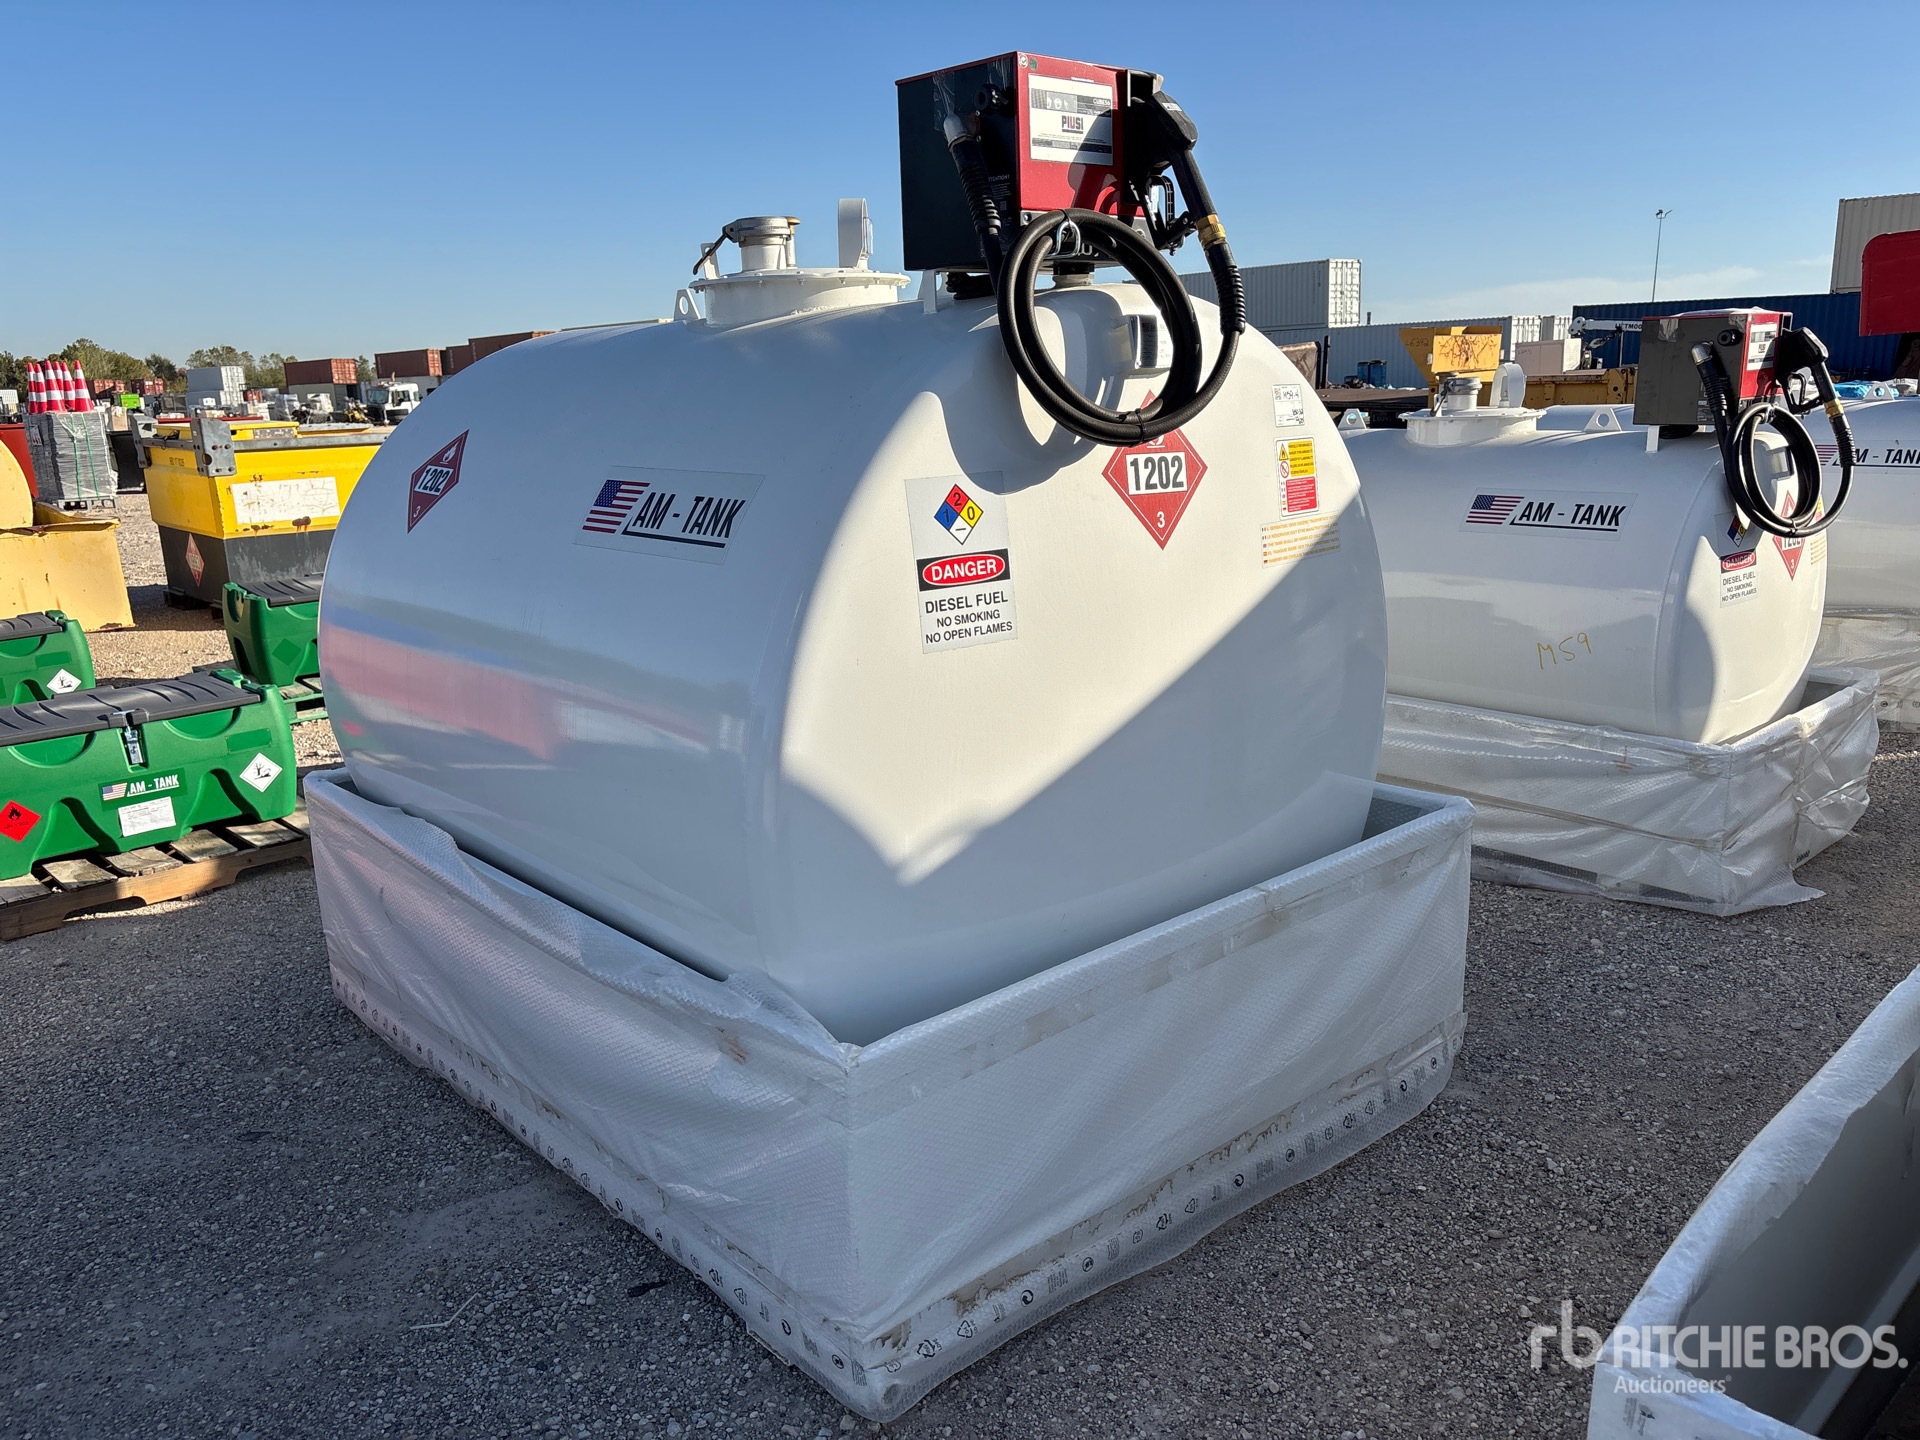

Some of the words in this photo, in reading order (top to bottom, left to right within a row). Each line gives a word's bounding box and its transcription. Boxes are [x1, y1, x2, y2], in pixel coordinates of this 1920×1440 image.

[1061, 115, 1084, 130] PIUSI
[417, 467, 451, 493] 1202
[1129, 455, 1185, 491] 1202
[953, 492, 962, 506] 2
[413, 505, 421, 518] 3
[632, 491, 676, 530] AM
[681, 496, 746, 538] TANK
[943, 508, 950, 523] 1
[966, 506, 976, 520] 0
[1156, 511, 1166, 528] 3
[1518, 501, 1555, 523] AM
[1570, 503, 1627, 527] TANK
[931, 558, 997, 582] DANGER
[1725, 553, 1753, 568] DANGER
[1722, 574, 1742, 586] DIESEL
[1742, 570, 1756, 581] FUEL
[1733, 581, 1753, 592] SMOKING
[925, 596, 972, 614] DIESEL
[975, 591, 1009, 607] FUEL
[1729, 592, 1741, 600] OPEN
[936, 616, 952, 628] NO
[954, 609, 1001, 625] SMOKING
[925, 632, 941, 644] NO
[943, 627, 972, 642] OPEN
[974, 621, 1013, 637] FLAMES
[1536, 632, 1592, 671] M59
[129, 782, 146, 794] AM
[153, 774, 180, 790] TANK
